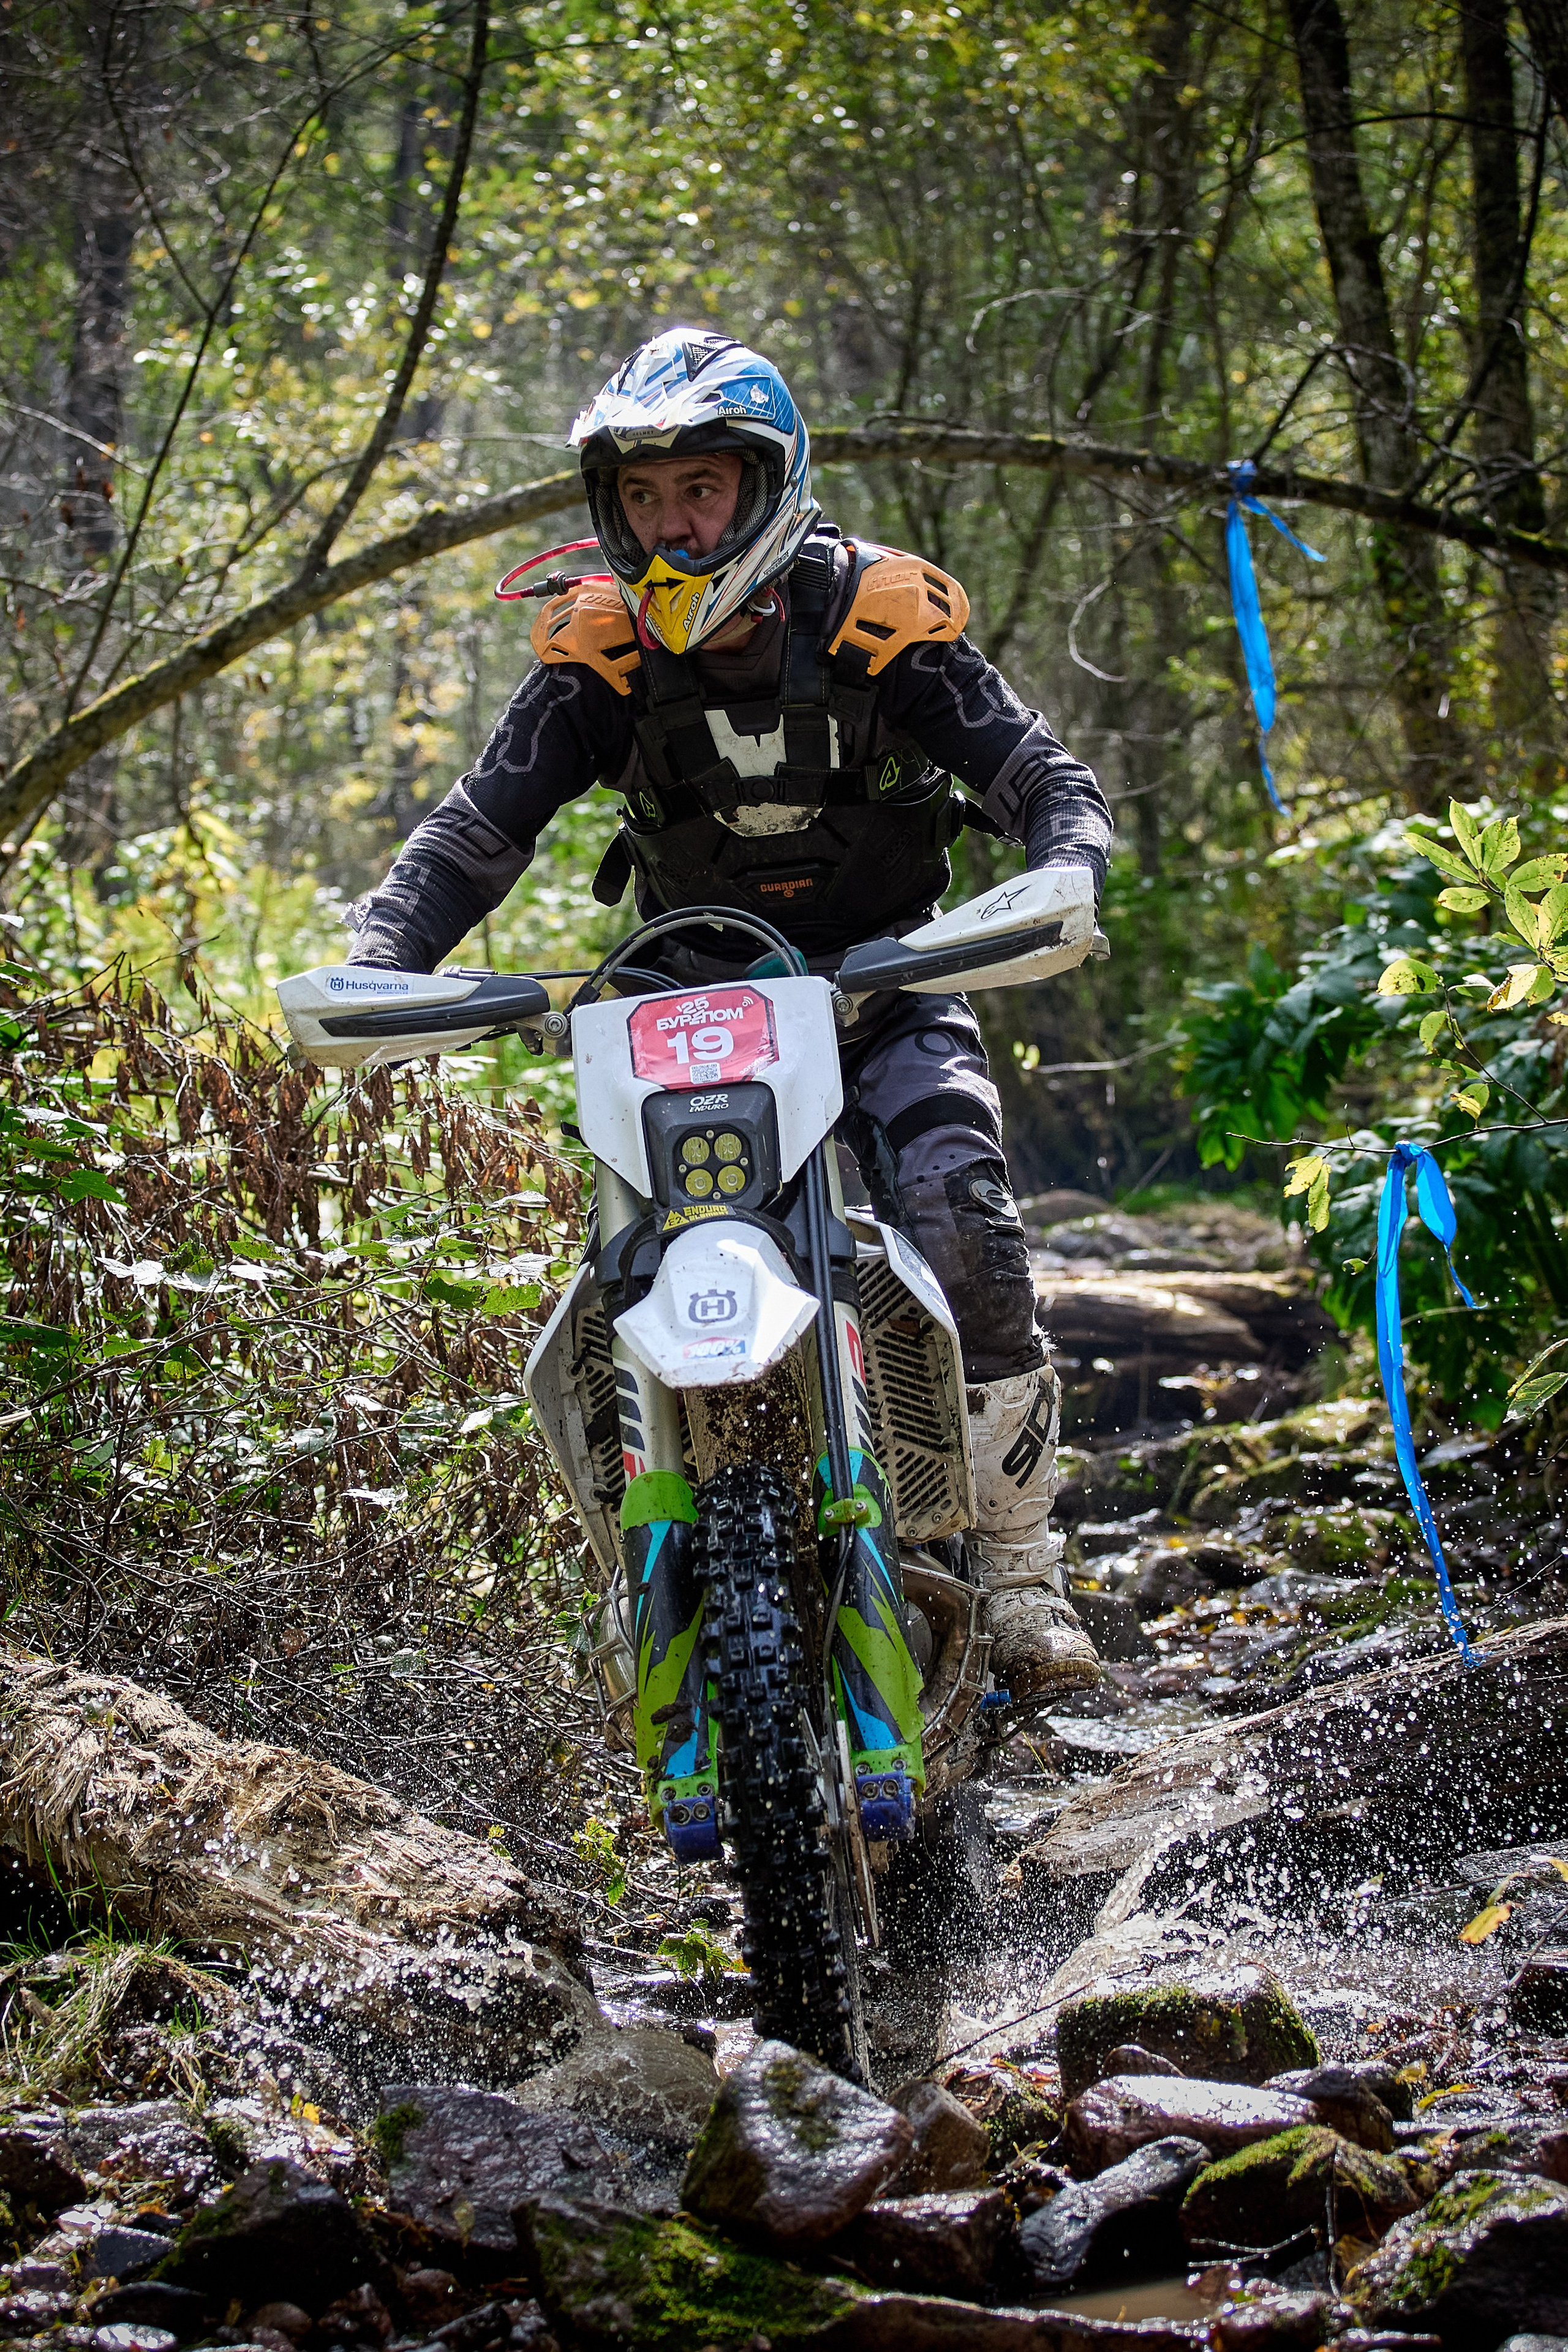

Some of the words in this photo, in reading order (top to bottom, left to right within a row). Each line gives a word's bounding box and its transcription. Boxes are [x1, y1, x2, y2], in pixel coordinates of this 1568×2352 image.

[718, 404, 747, 415] Airoh
[682, 592, 701, 632] Airoh
[345, 981, 409, 991] Husqvarna
[666, 1026, 734, 1065] 19
[690, 1093, 729, 1107] OZR
[689, 1103, 729, 1113] ENDURO
[683, 1205, 728, 1216] ENDURO
